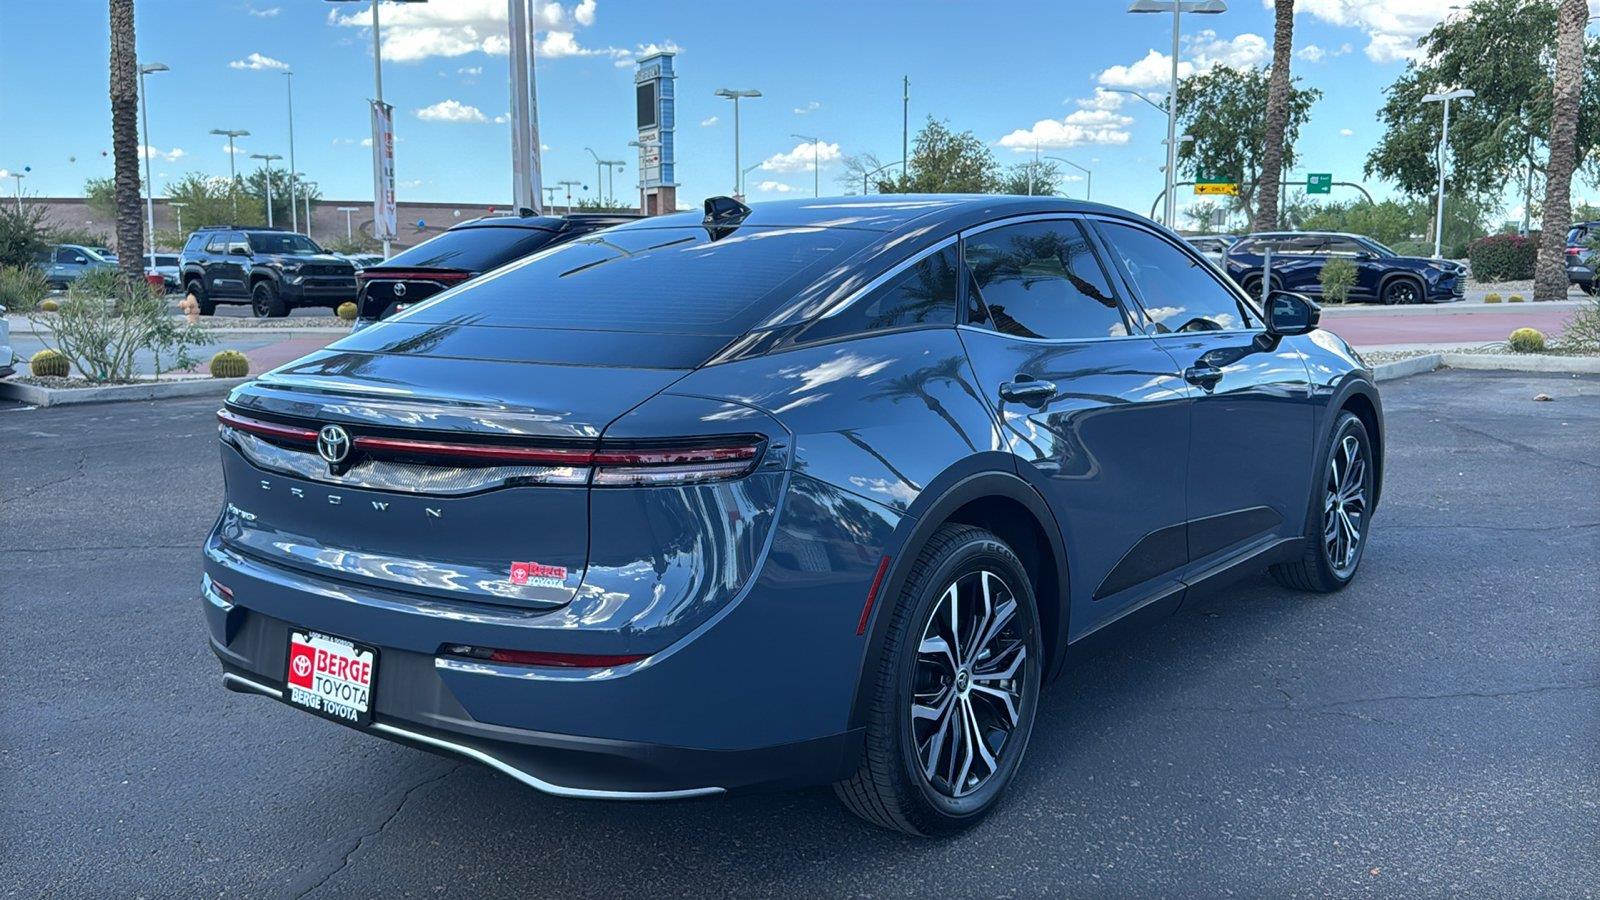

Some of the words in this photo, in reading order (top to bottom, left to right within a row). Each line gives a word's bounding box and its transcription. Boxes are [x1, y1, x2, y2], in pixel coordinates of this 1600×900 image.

[260, 480, 443, 519] CROWN
[528, 575, 564, 590] TOYOTA
[317, 649, 370, 684] BERGE
[291, 687, 321, 710] BERGE
[323, 700, 358, 722] TOYOTA
[316, 676, 368, 705] TOYOTA
